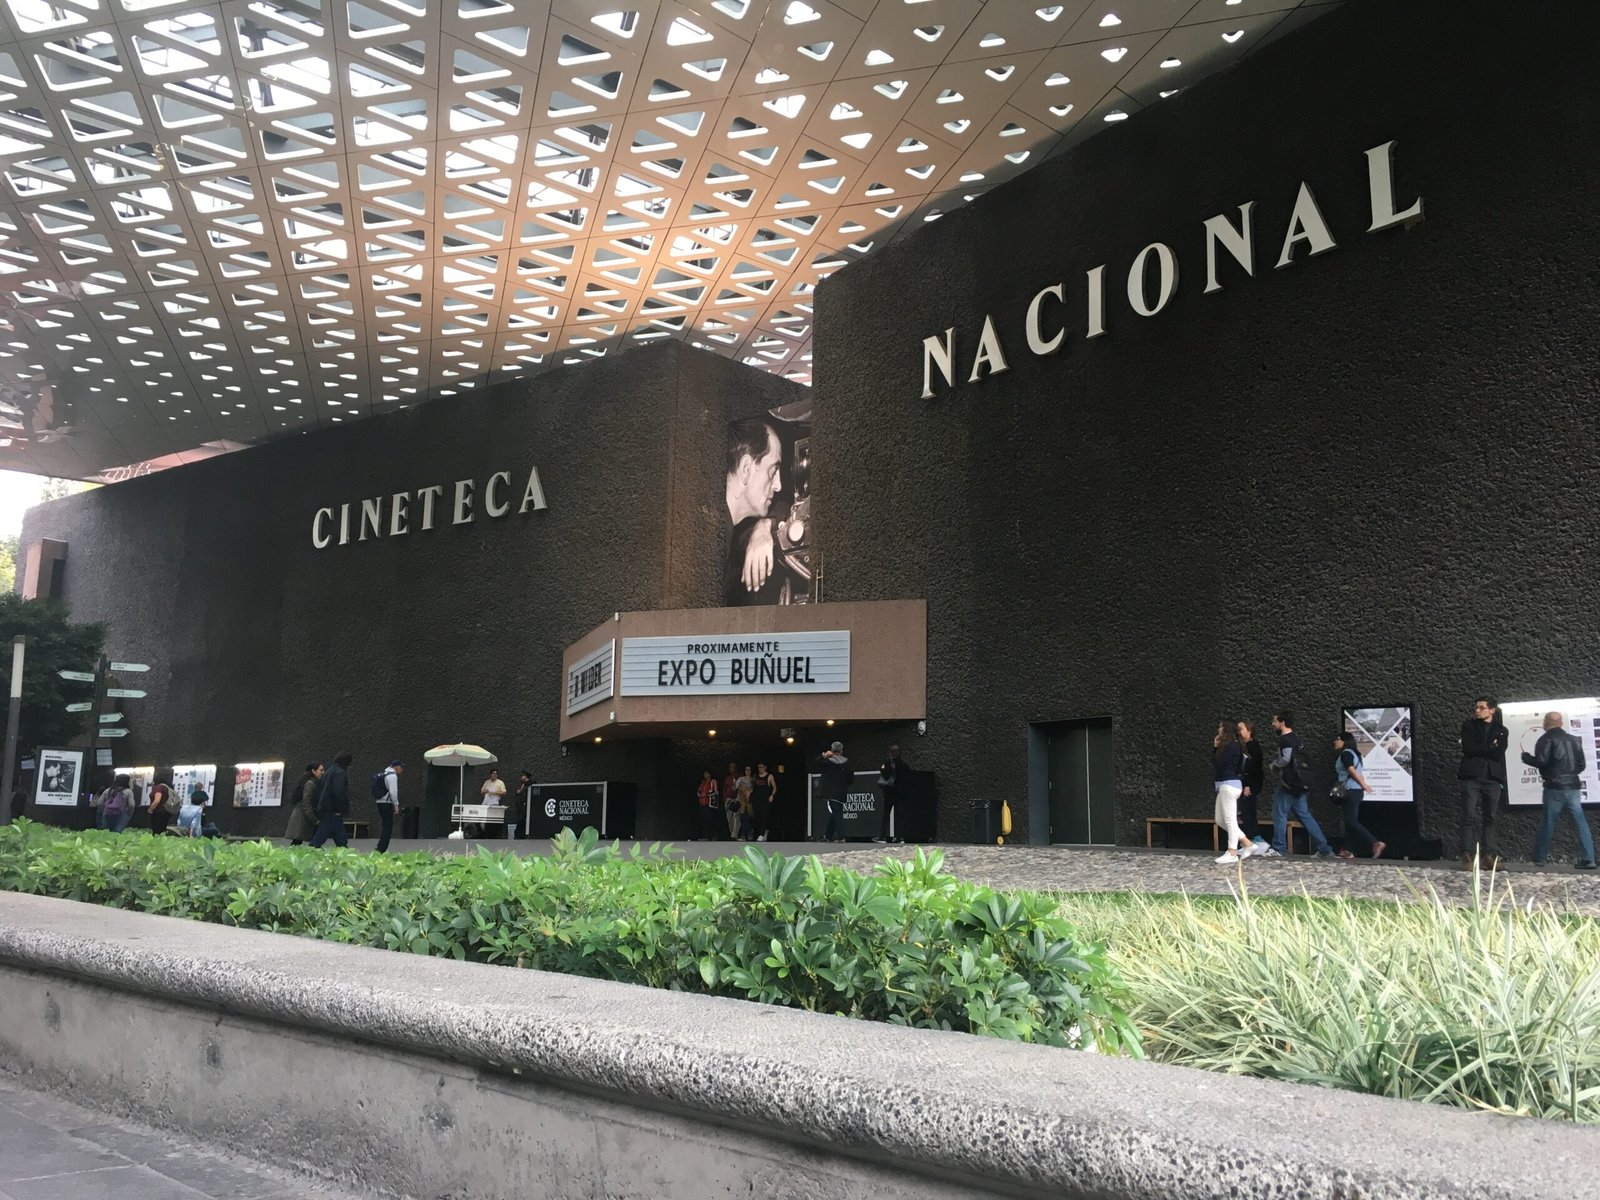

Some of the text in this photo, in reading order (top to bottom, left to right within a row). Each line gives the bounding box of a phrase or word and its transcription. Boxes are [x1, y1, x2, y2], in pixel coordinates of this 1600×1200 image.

[920, 140, 1424, 399] NACIONAL
[312, 466, 549, 549] CINETECA
[687, 641, 780, 654] PROXIMAMENTE
[658, 652, 815, 686] EXPO BUÑUEL
[559, 799, 590, 808] CINETECA
[845, 793, 875, 803] INETECA
[559, 807, 590, 815] NACIONAL
[842, 801, 876, 812] NACIONAL
